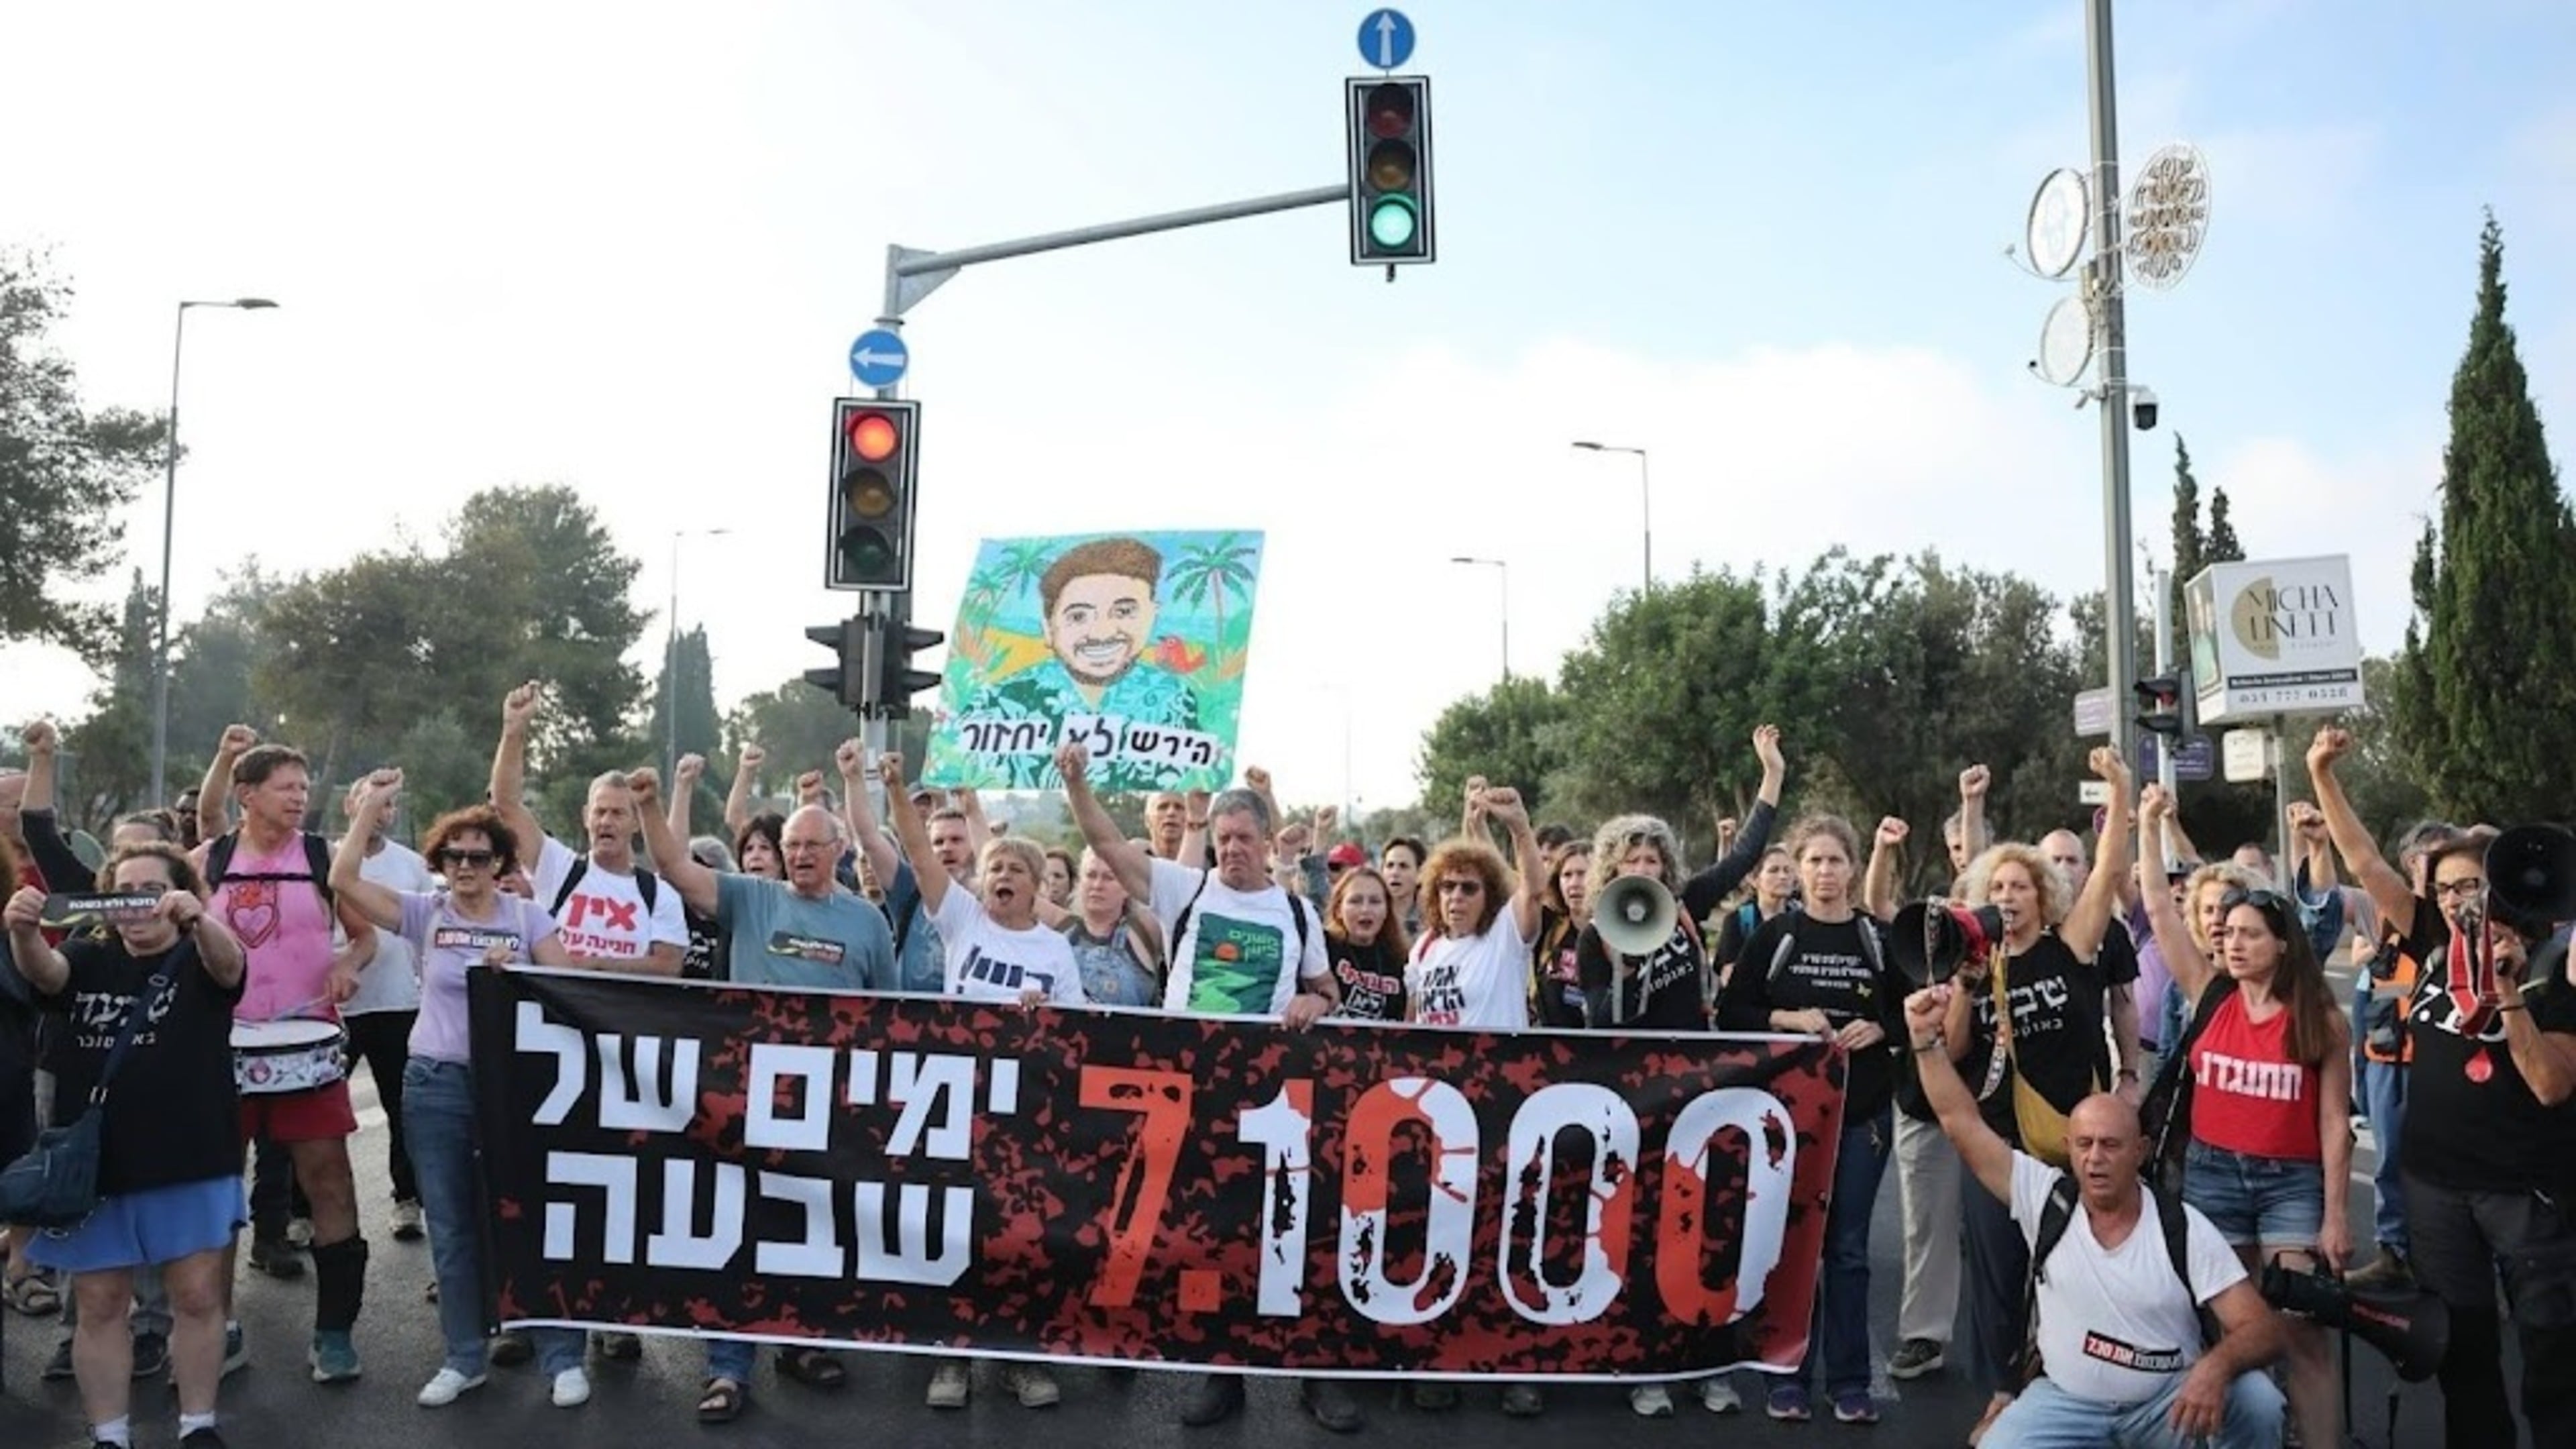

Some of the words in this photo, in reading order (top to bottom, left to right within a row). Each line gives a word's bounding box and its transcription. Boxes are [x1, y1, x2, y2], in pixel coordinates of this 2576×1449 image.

[962, 722, 1048, 753] יחזור
[1131, 730, 1212, 765] הירש
[566, 894, 637, 932] אין
[586, 934, 637, 955] חנינה
[515, 1000, 701, 1133] של
[744, 1042, 1020, 1161] ימים
[542, 1150, 975, 1287] שבעה
